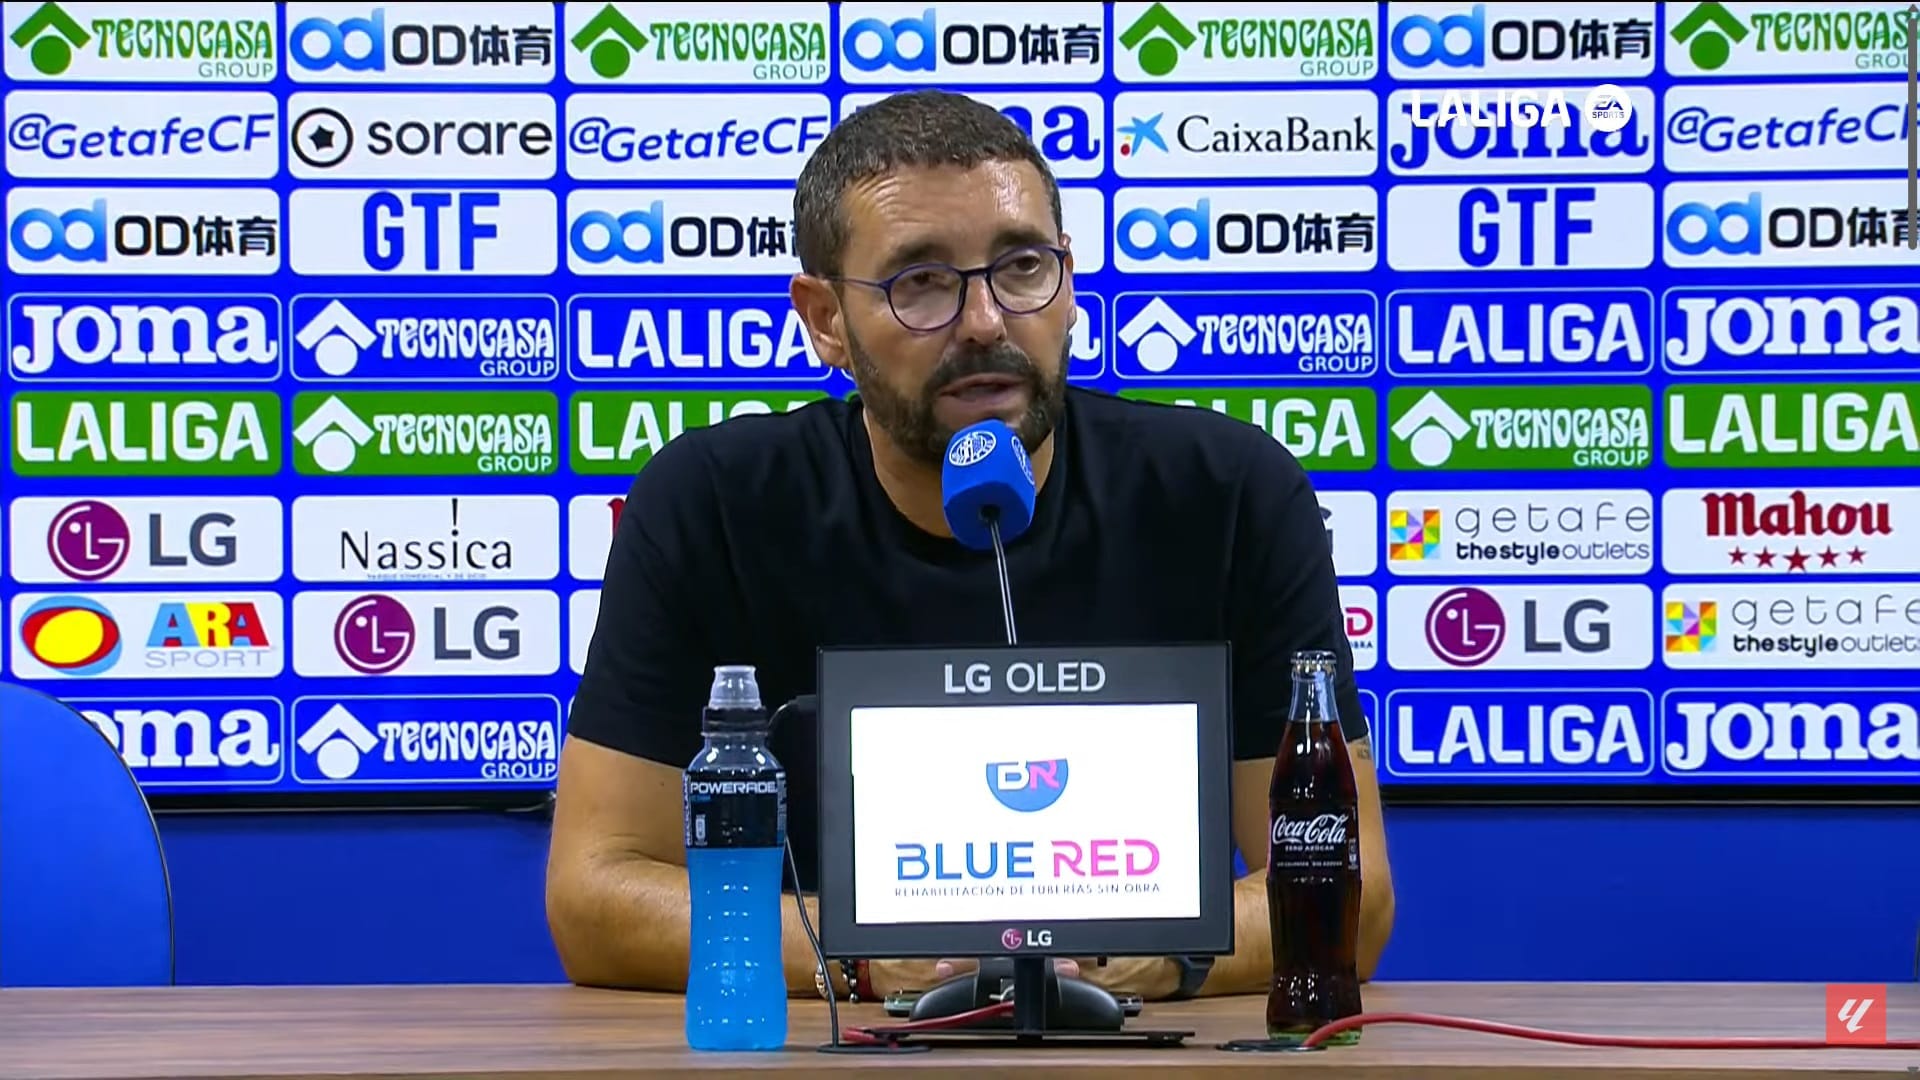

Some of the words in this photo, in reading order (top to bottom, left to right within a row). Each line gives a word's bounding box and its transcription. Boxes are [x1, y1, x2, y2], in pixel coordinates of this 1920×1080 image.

[92, 18, 273, 59] TECNOCASA
[650, 22, 826, 61] TECNOCASA
[1198, 18, 1374, 58] TECNOCASA
[1751, 10, 1909, 53] TECNOCAS
[198, 62, 274, 78] GROUP
[753, 64, 827, 80] GROUP
[1300, 60, 1374, 76] GROUP
[1855, 53, 1909, 70] GRO
[8, 113, 275, 160] @GetafeCF
[367, 121, 553, 156] sorare
[569, 116, 828, 163] @GetafeCF
[1177, 115, 1376, 153] CaixaBank
[363, 191, 501, 272] GTF
[670, 216, 797, 258] OD体
[1459, 187, 1596, 268] GTF
[375, 318, 555, 358] TECNOCASA
[577, 309, 822, 368] LALIGA
[1195, 314, 1373, 354] TECNOCASA
[1398, 303, 1644, 364] LALIGA
[480, 360, 555, 376] GROUP
[1298, 355, 1373, 373] GROUP
[17, 401, 269, 462] LALIGA
[373, 413, 553, 455] TECNOCASA
[1470, 408, 1649, 449] TECNOCASA
[1669, 392, 1920, 454] LALIGA
[477, 456, 552, 472] GROUP
[1572, 450, 1649, 467] GROUP
[1455, 502, 1651, 539] getafe
[1702, 489, 1893, 537] Mahou
[149, 513, 237, 567] LG
[341, 498, 512, 570] Nassica
[146, 602, 270, 647] ARA
[434, 606, 521, 661] LG
[1350, 640, 1374, 649] BRA
[1524, 599, 1611, 654] LG
[145, 650, 271, 668] SPORT
[944, 663, 992, 694] LG
[1006, 662, 1106, 693] OLED
[376, 720, 556, 762] TECNOCASA
[1398, 705, 1645, 765] LALIGA
[481, 762, 557, 778] GROUP
[690, 781, 779, 794] POWERADE
[1272, 814, 1349, 845] Coca-Cola
[895, 841, 1035, 881] BLUE
[1050, 839, 1161, 878] RED
[1124, 882, 1160, 893] OBRA
[1027, 930, 1053, 946] LG
